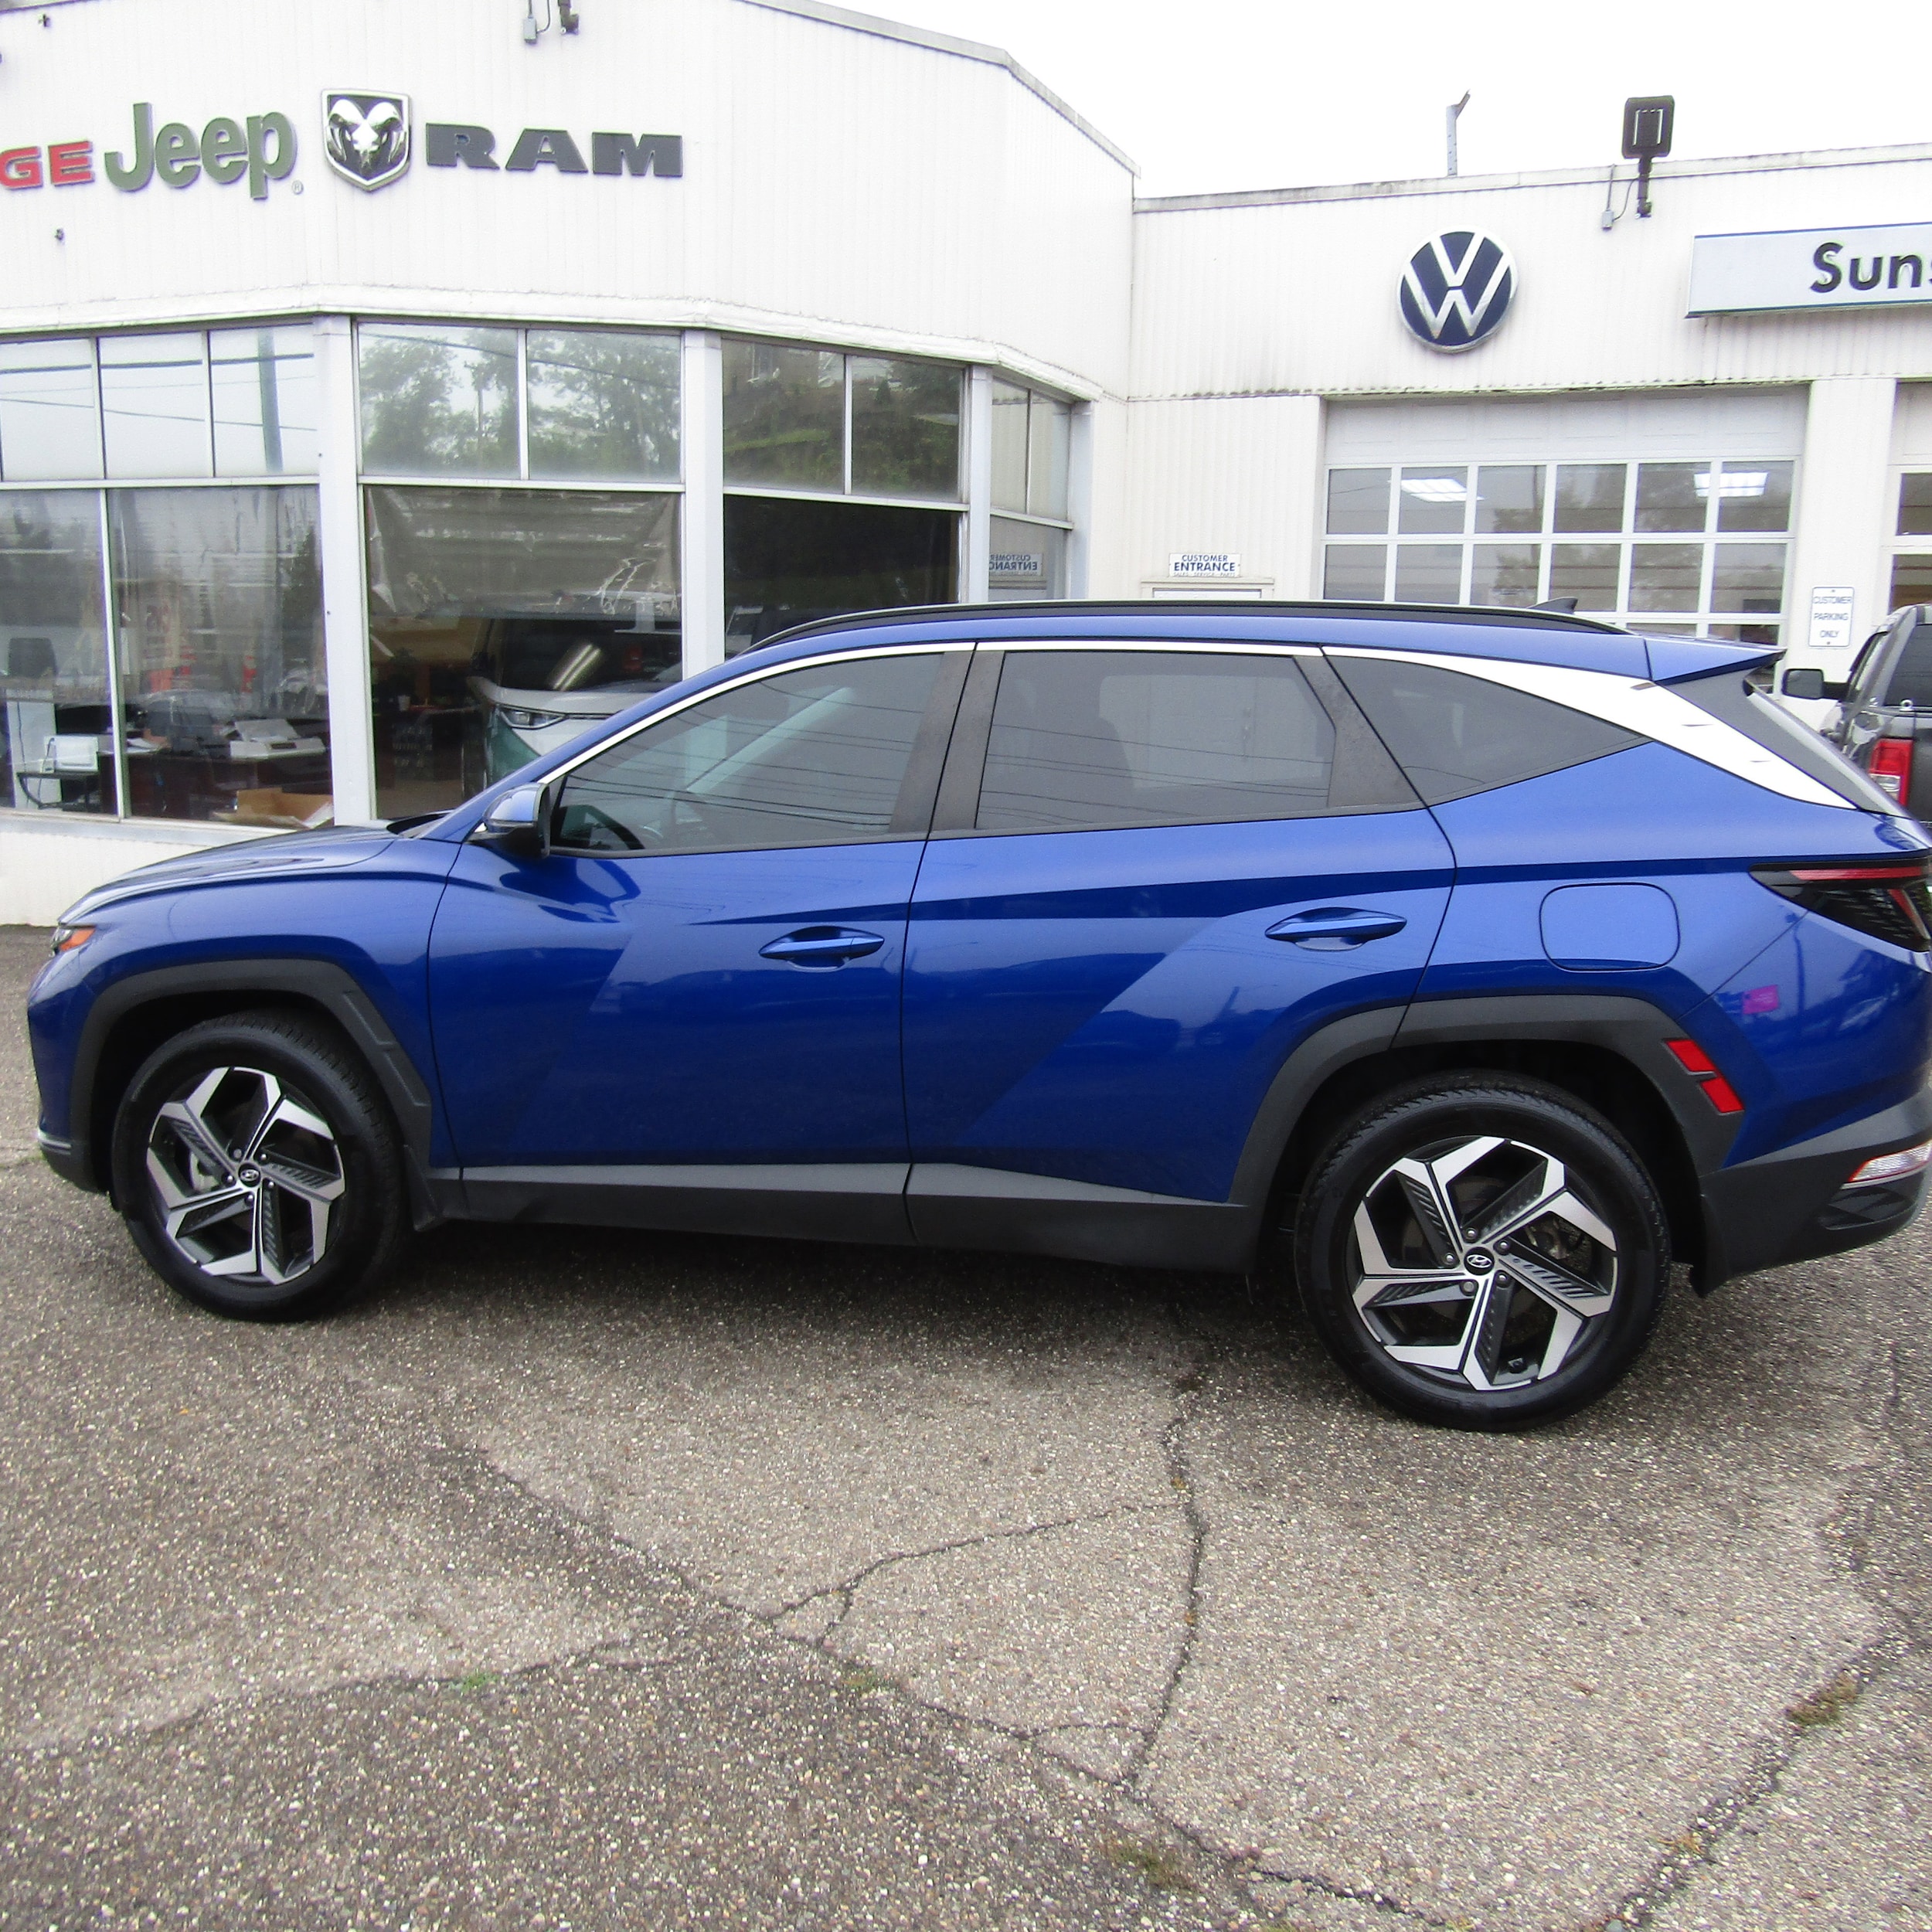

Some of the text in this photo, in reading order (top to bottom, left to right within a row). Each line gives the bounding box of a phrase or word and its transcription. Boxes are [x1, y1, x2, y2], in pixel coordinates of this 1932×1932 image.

[104, 102, 298, 201] Jeep
[425, 122, 683, 177] RAM
[1810, 242, 1932, 293] Sun
[1174, 563, 1236, 571] ENTRANCE
